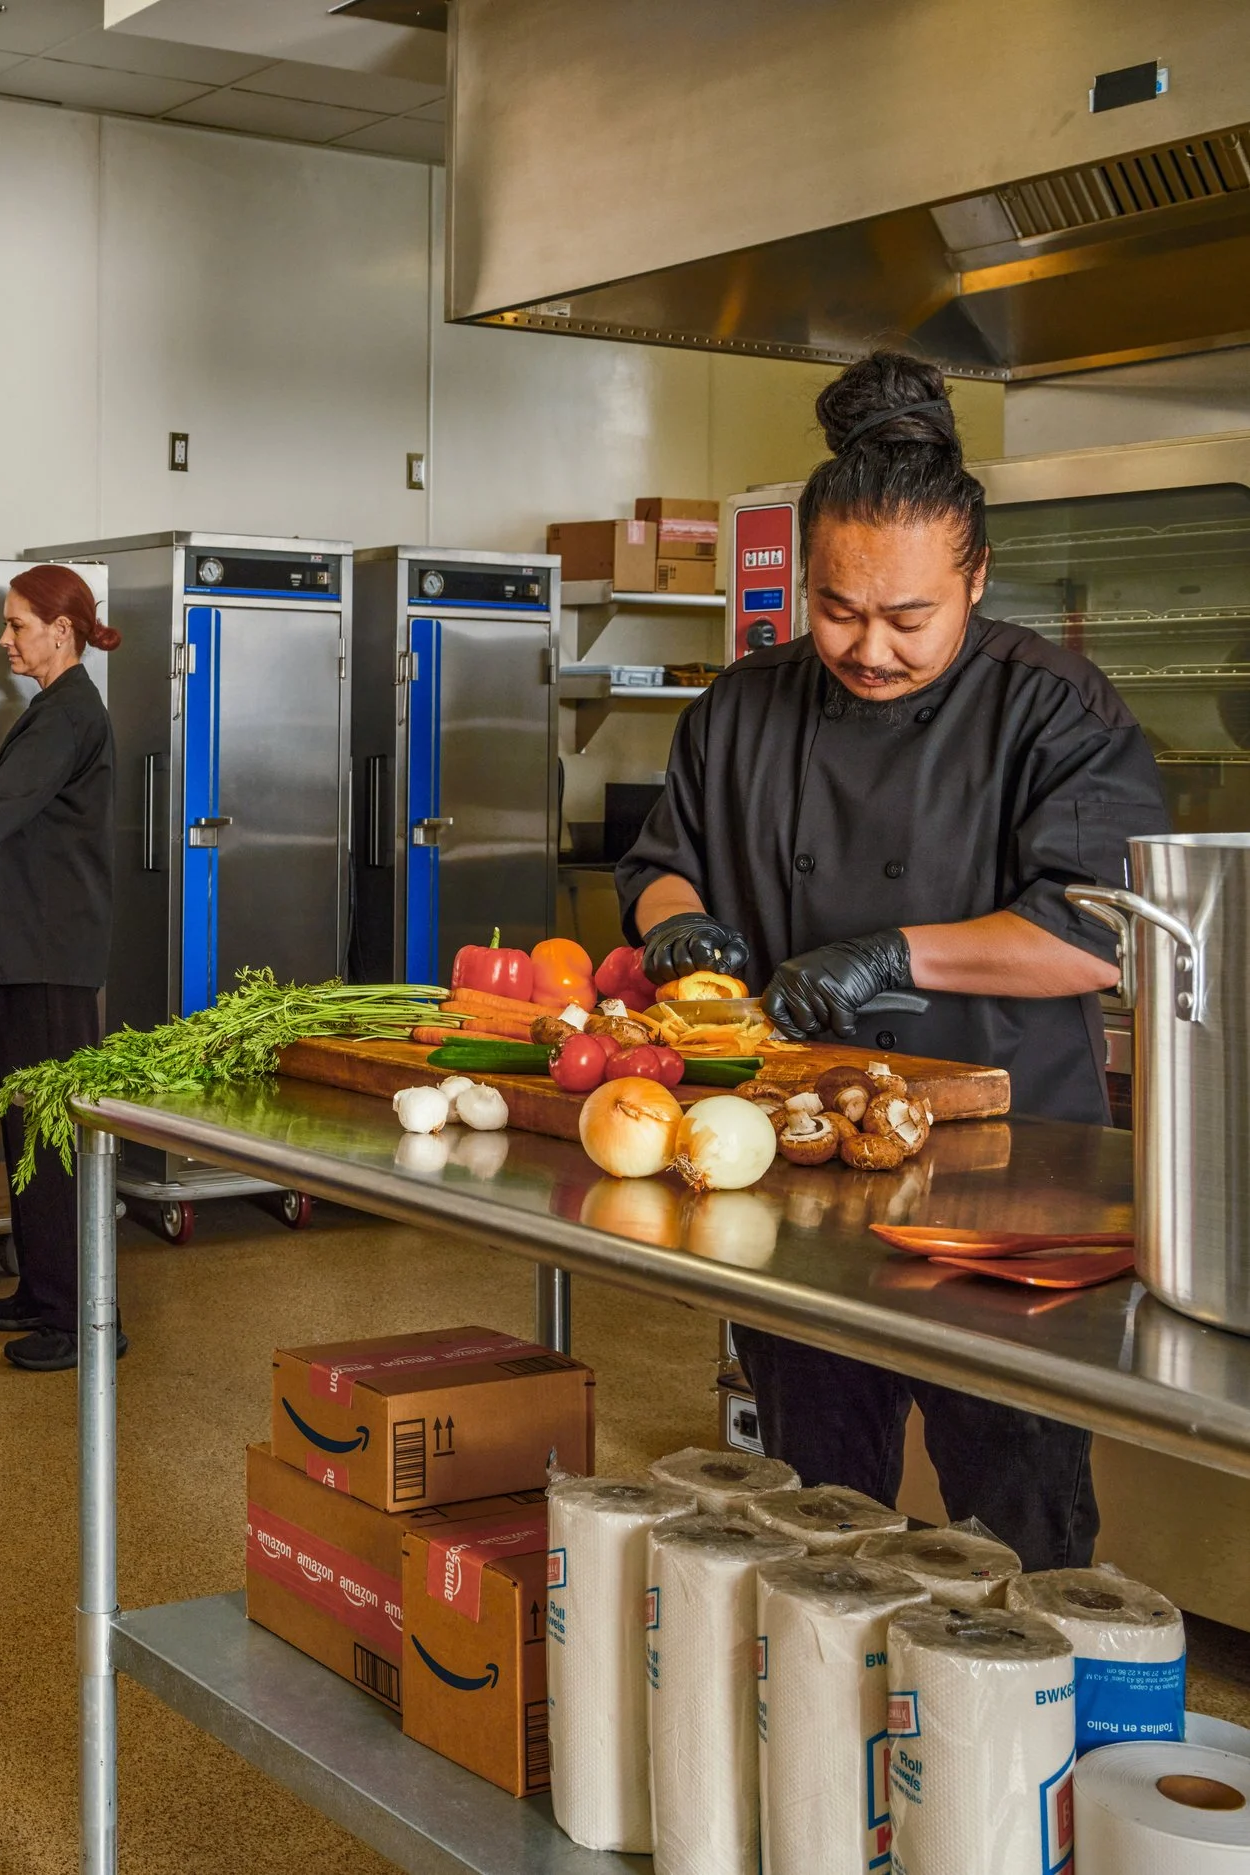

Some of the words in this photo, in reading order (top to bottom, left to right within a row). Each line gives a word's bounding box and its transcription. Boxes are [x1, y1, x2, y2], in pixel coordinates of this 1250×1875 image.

[380, 1354, 436, 1368] amazon
[257, 1529, 292, 1559] amazon
[297, 1551, 334, 1583] amazon
[339, 1575, 379, 1607] amazon
[444, 1543, 471, 1602] amazon
[550, 1600, 565, 1620] Roll
[1086, 1720, 1119, 1733] Rollo
[1122, 1723, 1137, 1733] en
[1140, 1722, 1173, 1735] Toallas
[900, 1750, 922, 1776] Roll
